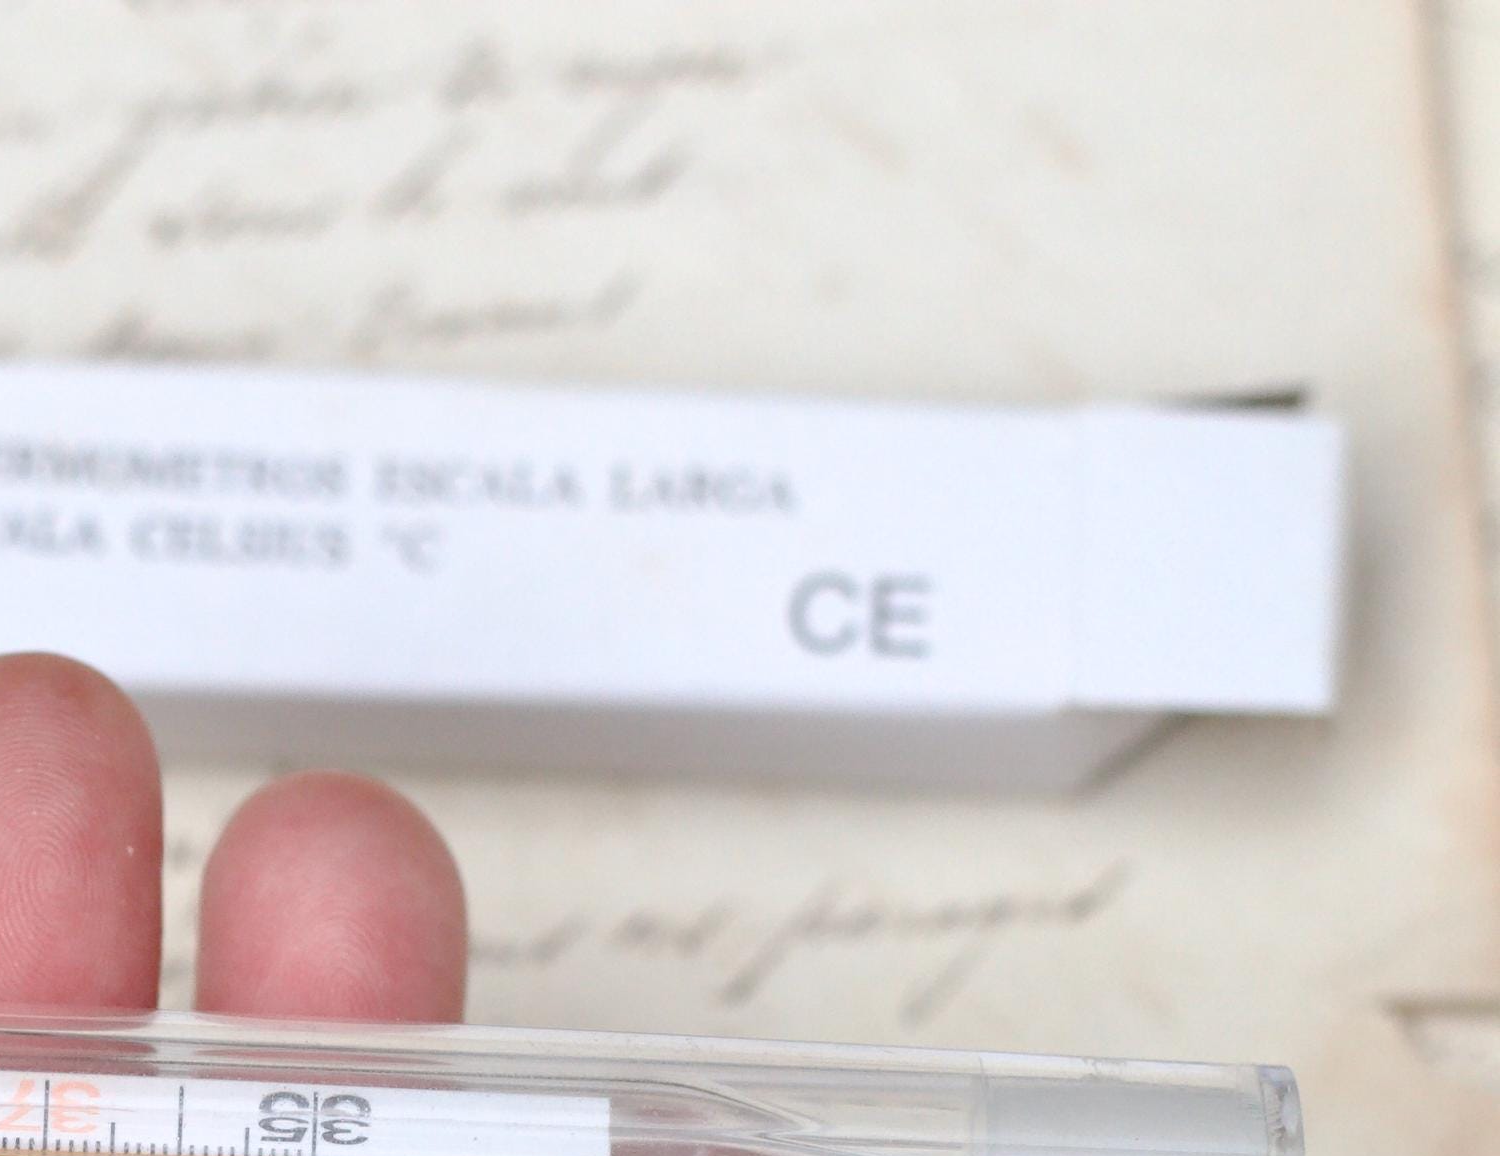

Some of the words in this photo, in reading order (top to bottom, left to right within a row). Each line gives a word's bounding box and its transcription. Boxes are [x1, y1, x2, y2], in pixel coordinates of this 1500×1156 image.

[373, 455, 583, 508] ESCALA
[609, 460, 798, 513] LARGA
[785, 570, 933, 660] CE
[257, 1116, 371, 1145] 35
